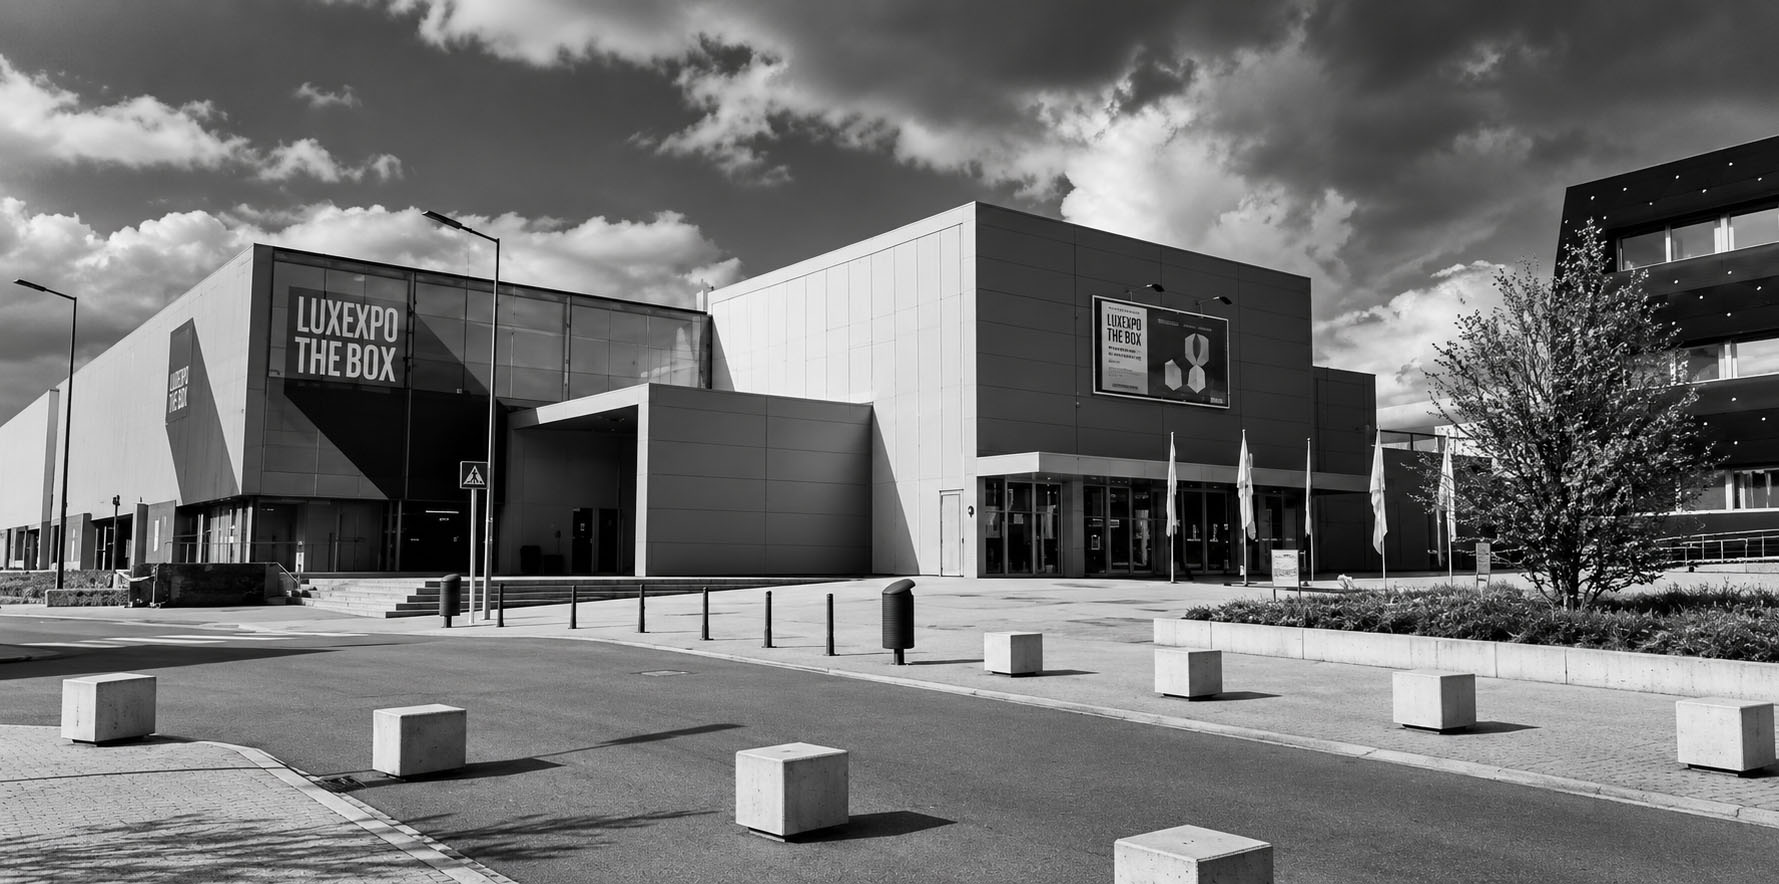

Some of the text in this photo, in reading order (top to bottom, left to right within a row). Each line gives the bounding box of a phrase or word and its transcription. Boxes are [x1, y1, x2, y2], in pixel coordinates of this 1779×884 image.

[297, 296, 398, 343] LUXEXPO
[1107, 313, 1142, 331] LUXEXPO
[1107, 328, 1142, 346] THE BOX
[295, 336, 396, 382] THE BOX
